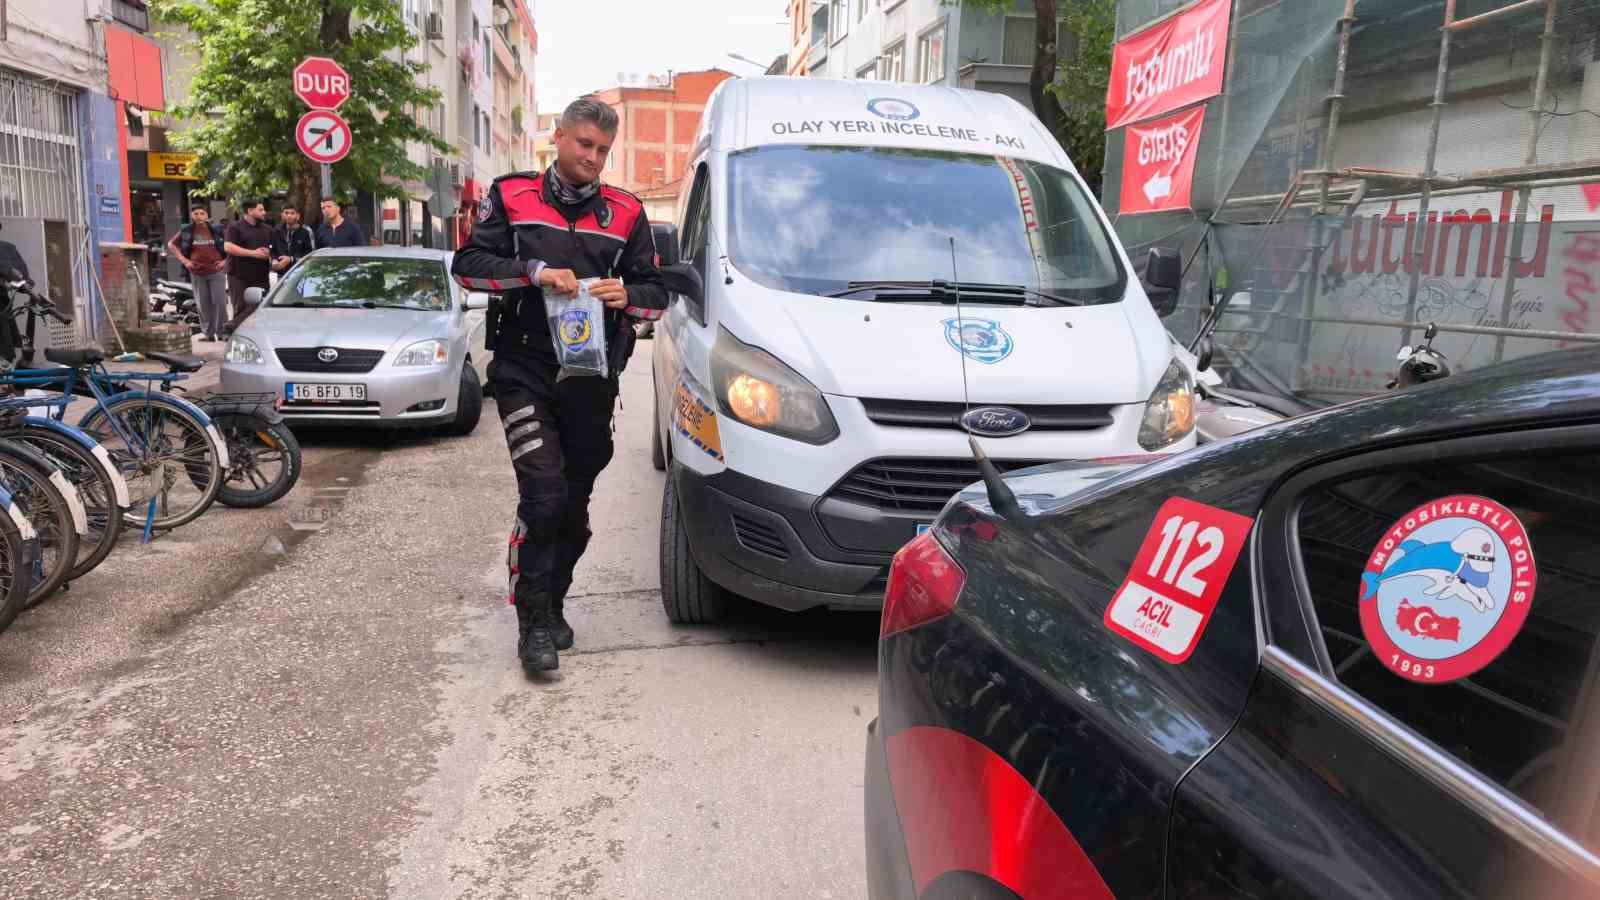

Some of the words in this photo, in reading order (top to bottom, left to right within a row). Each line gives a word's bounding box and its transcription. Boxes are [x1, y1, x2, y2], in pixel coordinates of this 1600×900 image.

[1124, 26, 1214, 106] tutumlu
[298, 72, 346, 95] DUR
[772, 121, 823, 135] OLAY
[1138, 122, 1188, 166] GİRİŞ
[1330, 190, 1554, 278] tutumlu
[296, 385, 310, 398] 16
[317, 386, 341, 398] BFD
[350, 386, 364, 398] 19
[978, 411, 1016, 425] Ford
[1147, 515, 1225, 598] 112
[1374, 502, 1513, 566] MOTOSİKLETLİ
[1509, 536, 1532, 603] POLİS
[1136, 596, 1173, 628] ACİL
[1391, 653, 1435, 678] 1993
